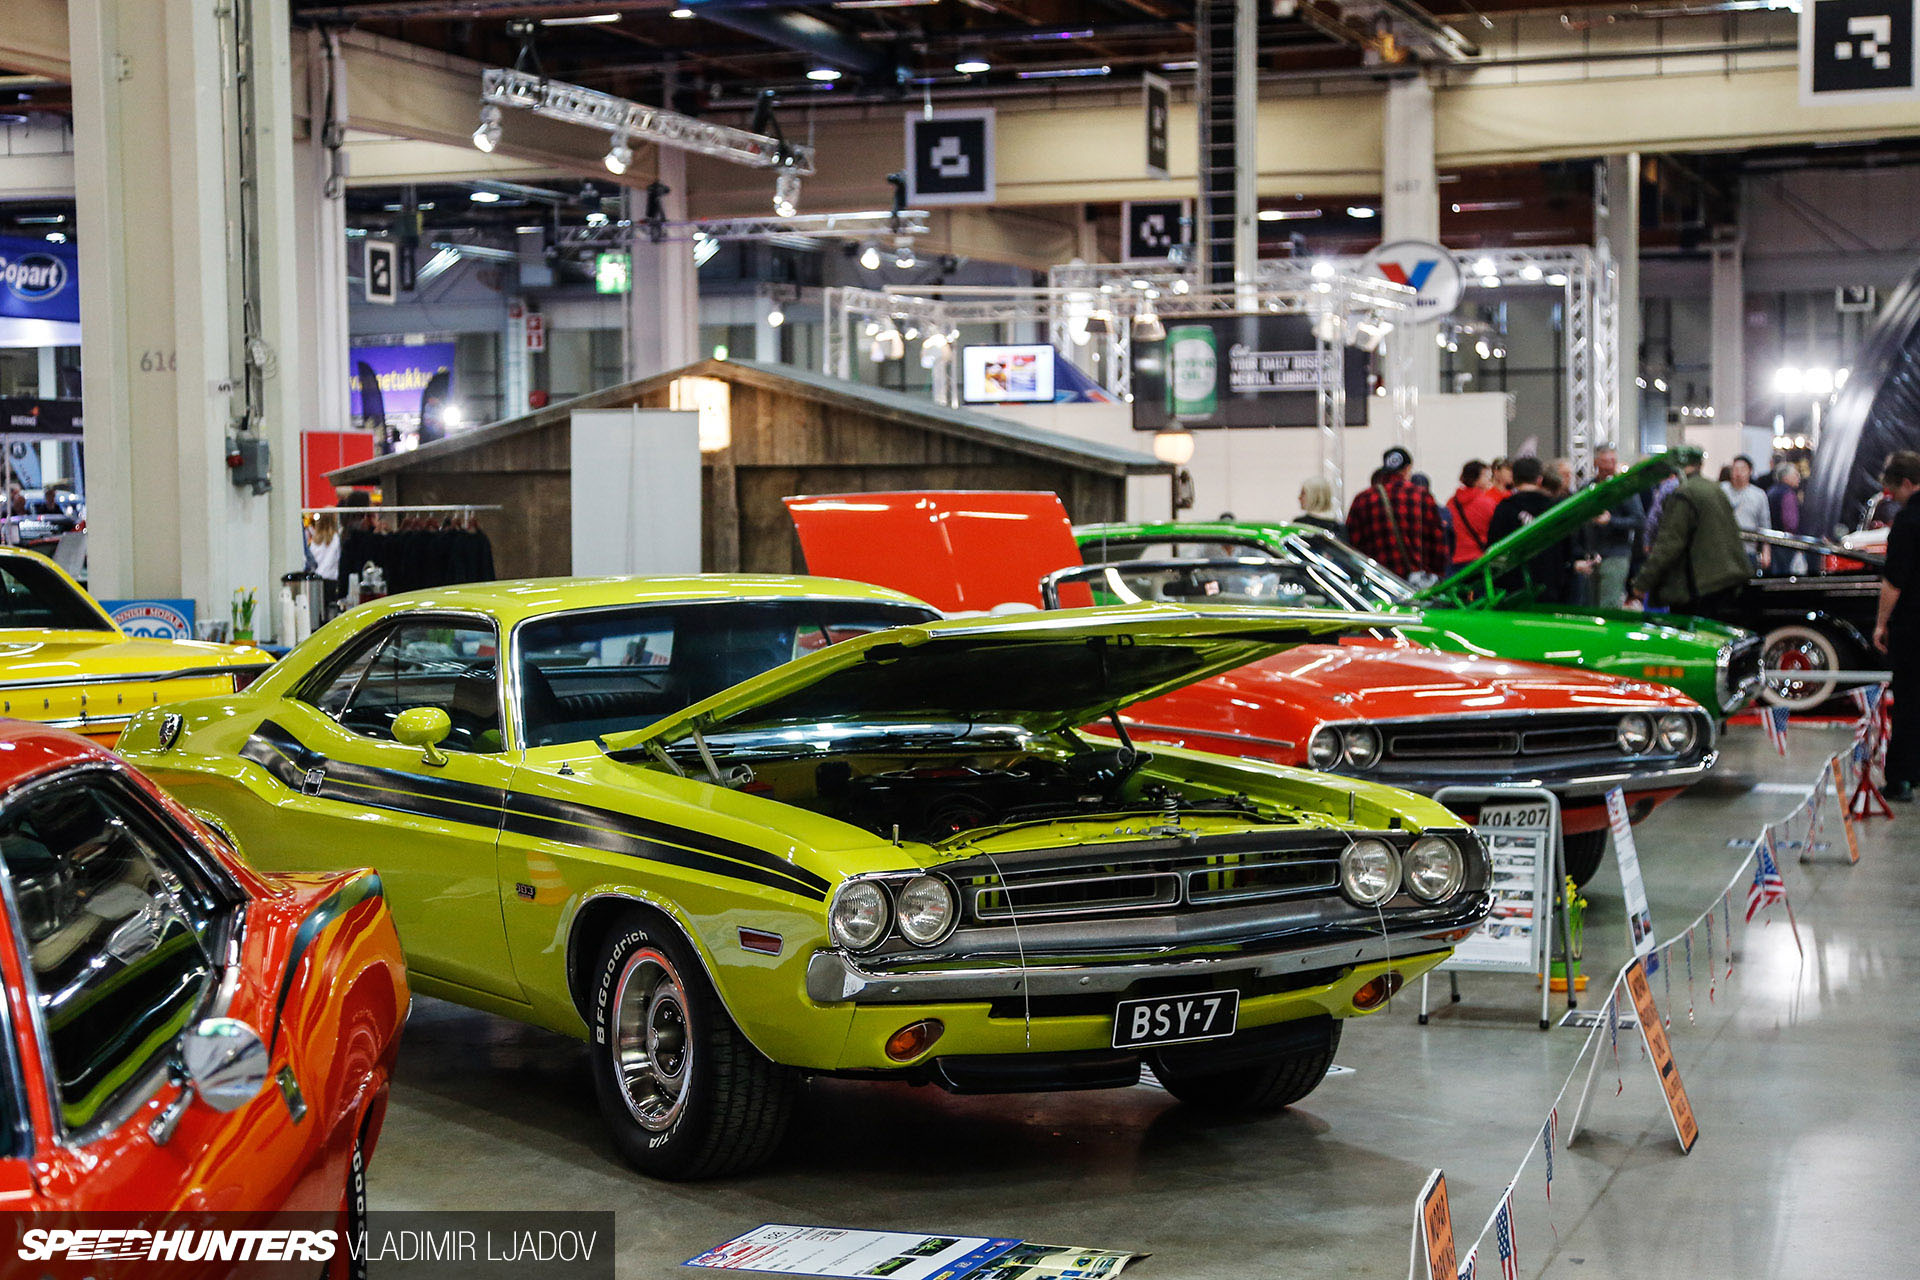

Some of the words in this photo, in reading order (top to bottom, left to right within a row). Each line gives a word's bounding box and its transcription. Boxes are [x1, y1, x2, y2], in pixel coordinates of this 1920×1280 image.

[1262, 356, 1290, 371] DAILY
[1274, 370, 1338, 384] LUBRICAIO
[1482, 810, 1548, 826] KOA-207
[596, 930, 649, 1045] BFGoodrich
[1131, 998, 1211, 1039] BSY-7
